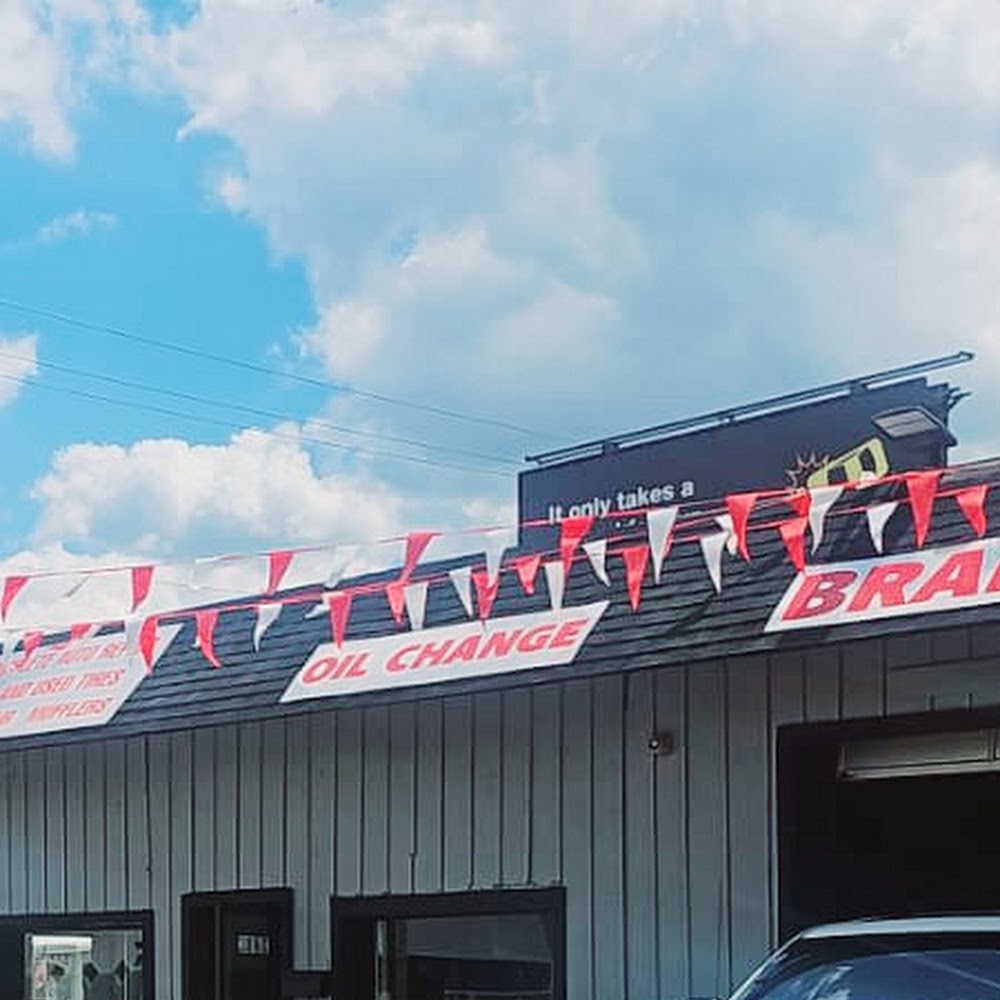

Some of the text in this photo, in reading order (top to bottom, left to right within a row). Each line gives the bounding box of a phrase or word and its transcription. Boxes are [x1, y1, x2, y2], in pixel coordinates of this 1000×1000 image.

[569, 498, 610, 518] only
[617, 484, 674, 510] takes
[681, 481, 694, 498] a
[781, 549, 1000, 621] BRA
[302, 619, 588, 684] OIL CHANGE
